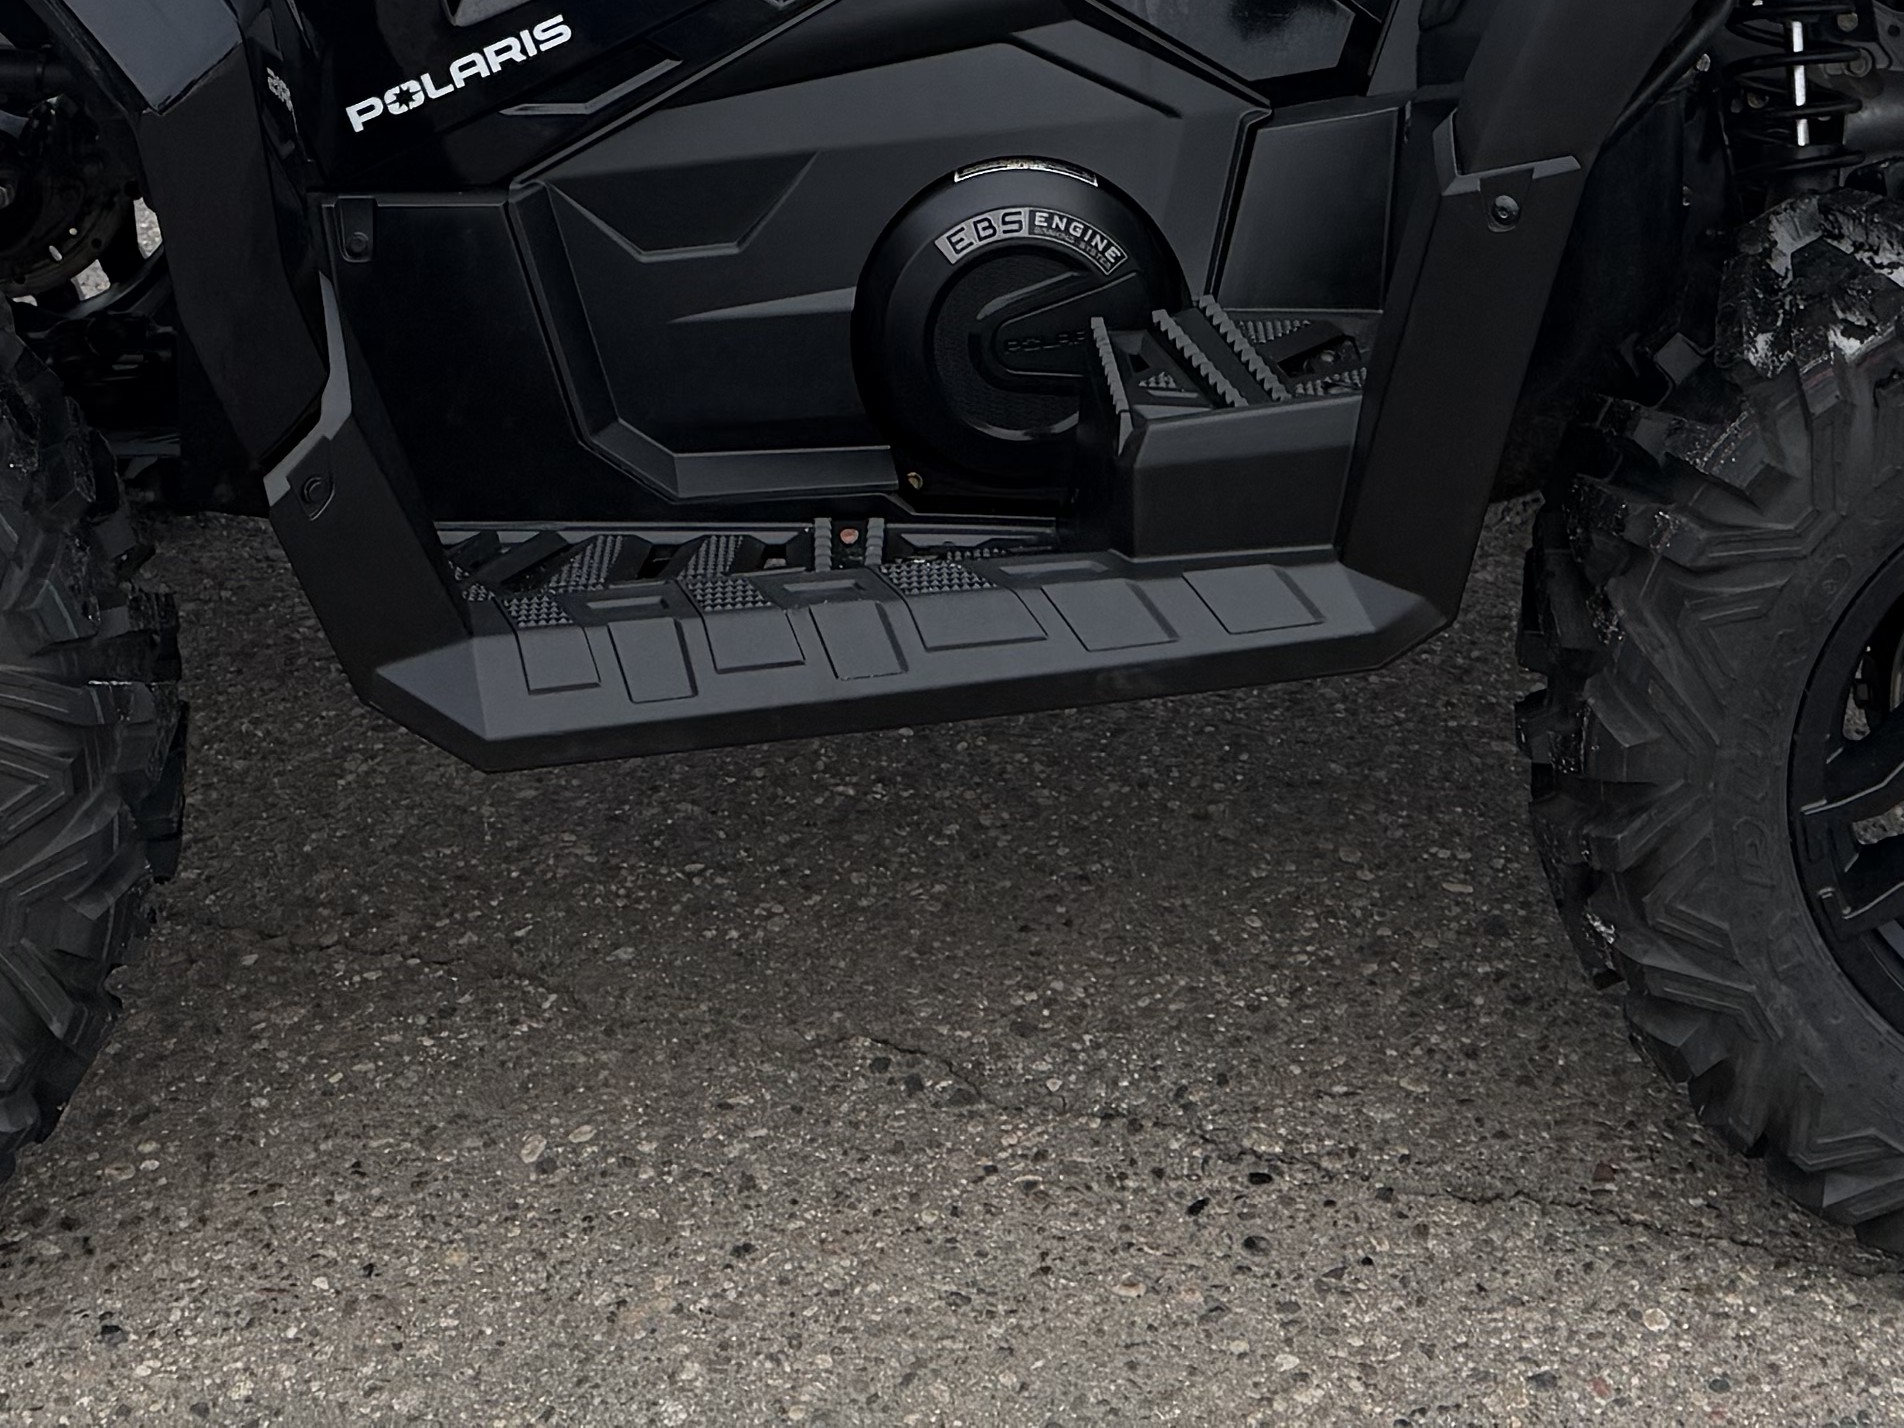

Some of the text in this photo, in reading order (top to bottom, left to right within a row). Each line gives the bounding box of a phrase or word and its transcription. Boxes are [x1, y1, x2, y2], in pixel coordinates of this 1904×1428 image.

[345, 14, 573, 133] POLARIS
[946, 211, 1122, 264] EBS ENGINE
